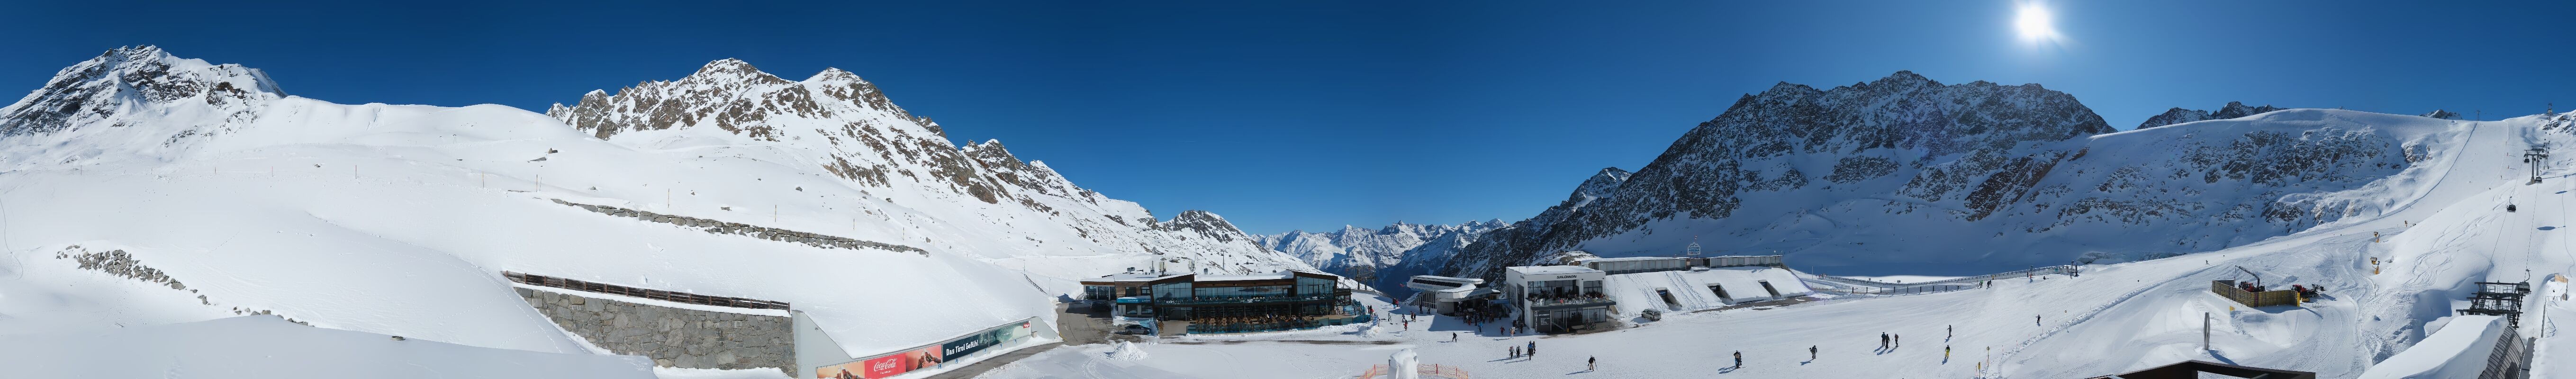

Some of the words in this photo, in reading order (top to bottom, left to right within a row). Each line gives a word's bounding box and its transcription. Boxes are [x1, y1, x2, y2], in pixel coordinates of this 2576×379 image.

[955, 344, 965, 353] Tirol
[966, 340, 978, 350] Gefühl
[874, 358, 897, 371] Coca-Cola
